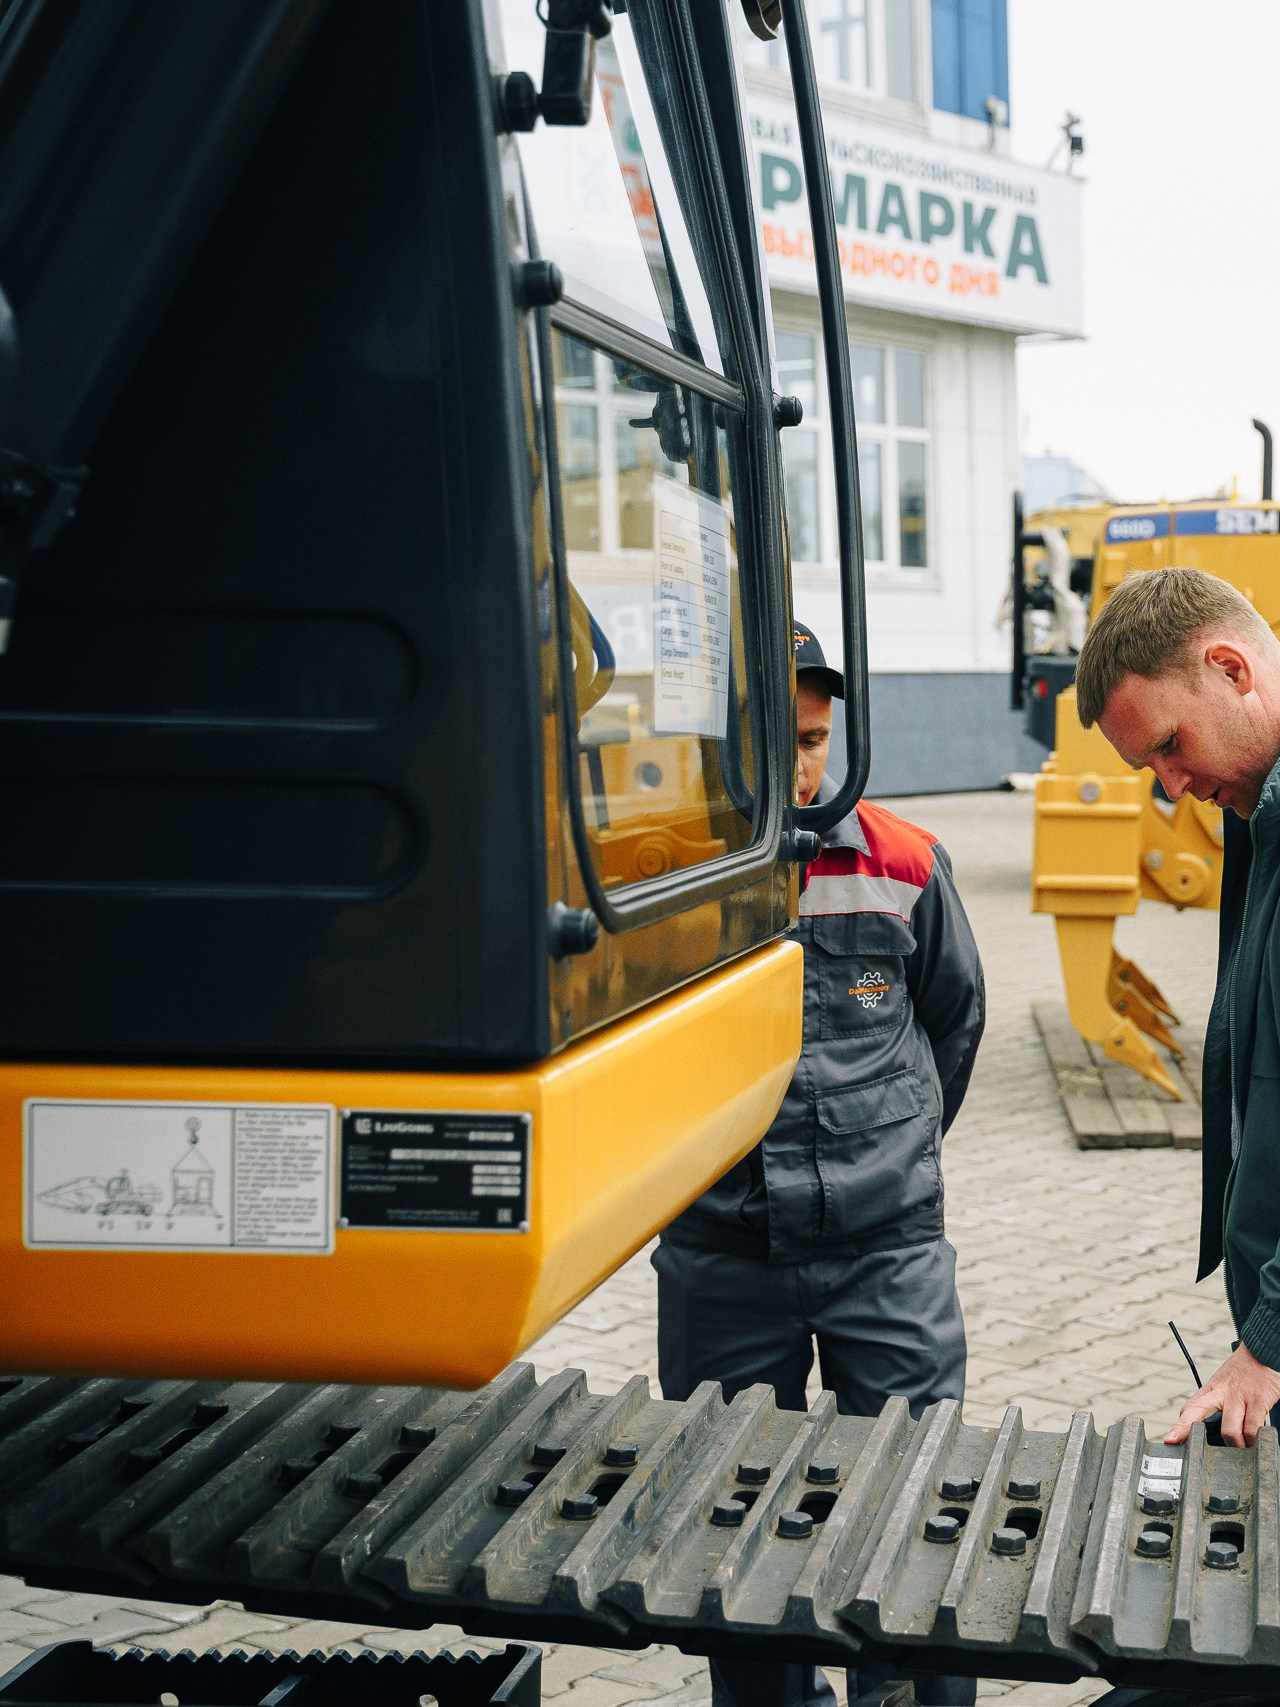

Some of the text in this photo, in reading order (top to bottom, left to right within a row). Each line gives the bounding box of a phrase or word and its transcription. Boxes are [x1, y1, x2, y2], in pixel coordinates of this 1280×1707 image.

[760, 152, 1049, 285] РМАРКА
[763, 223, 941, 286] ВЫДНОГО
[1215, 508, 1280, 534] SEM
